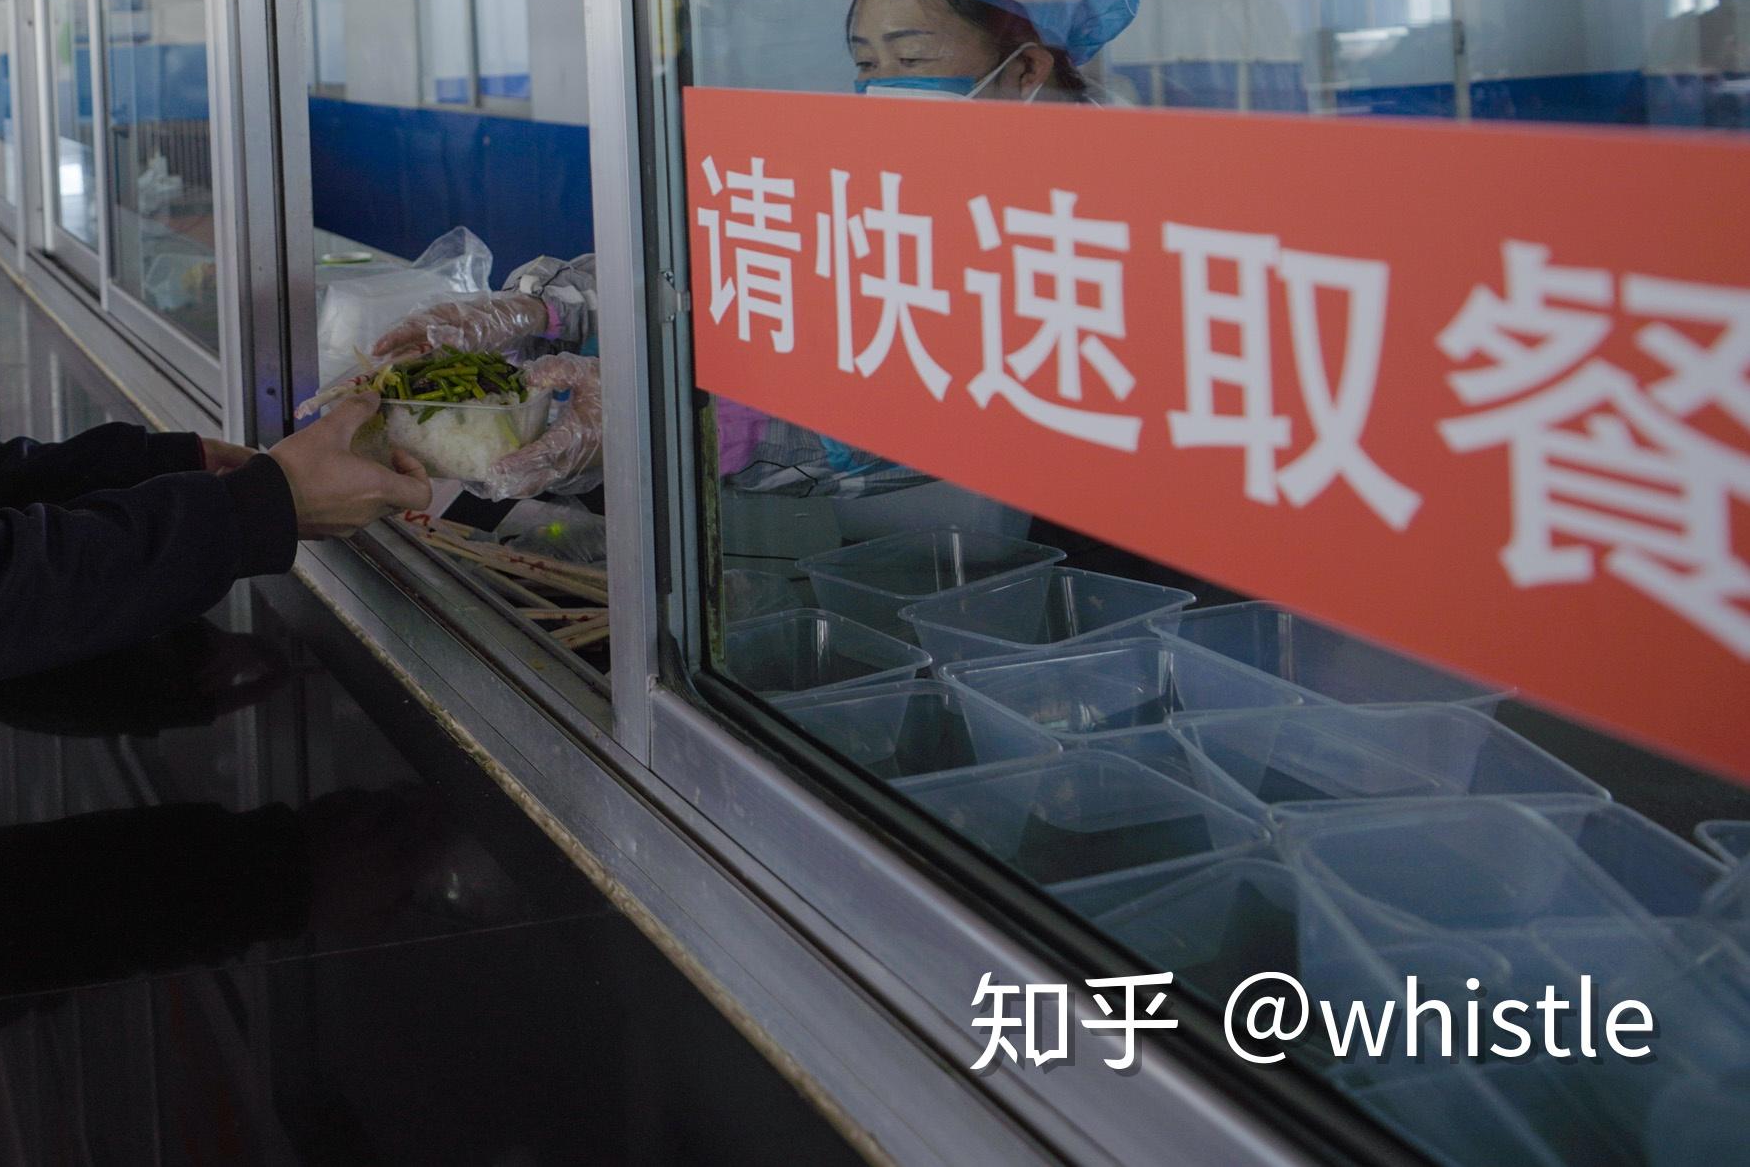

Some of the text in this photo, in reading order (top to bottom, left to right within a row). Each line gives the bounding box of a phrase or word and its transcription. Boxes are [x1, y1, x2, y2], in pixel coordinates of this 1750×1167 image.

[696, 155, 1750, 662] 请快速取餐
